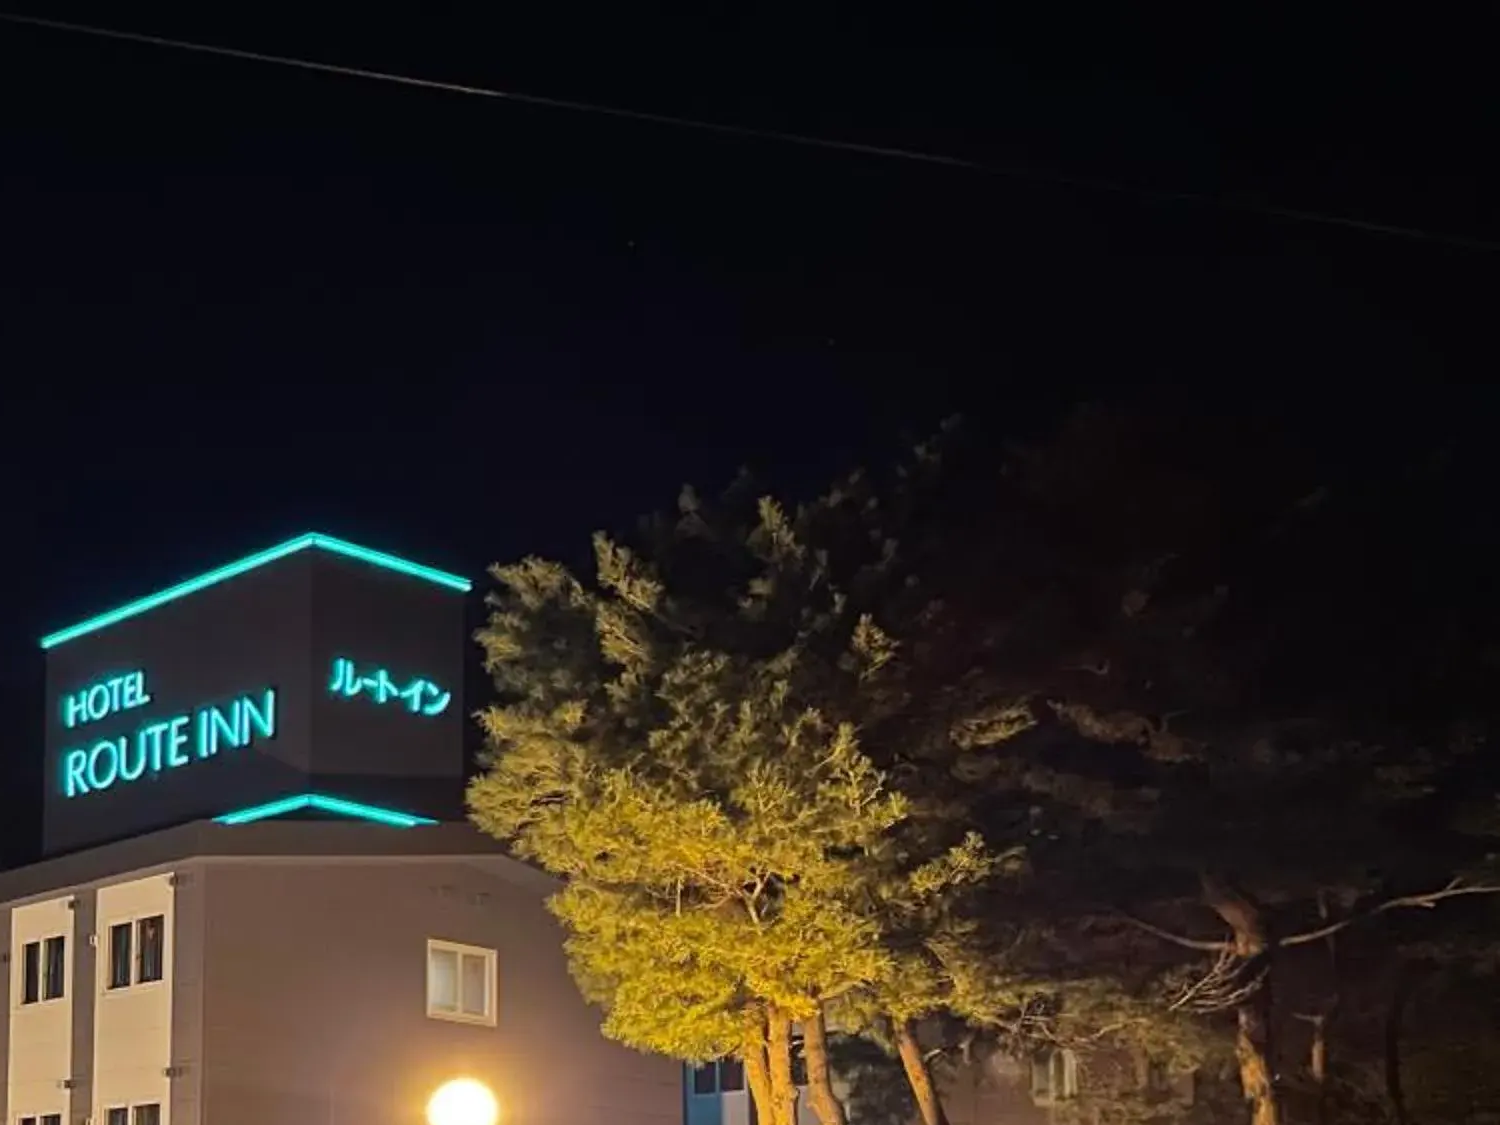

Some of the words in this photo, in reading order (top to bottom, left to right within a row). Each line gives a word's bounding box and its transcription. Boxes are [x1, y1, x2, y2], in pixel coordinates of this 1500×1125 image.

[65, 670, 150, 727] HOTEL
[330, 657, 452, 714] ルートイン
[65, 715, 190, 797] ROUTE
[198, 689, 276, 759] INN
